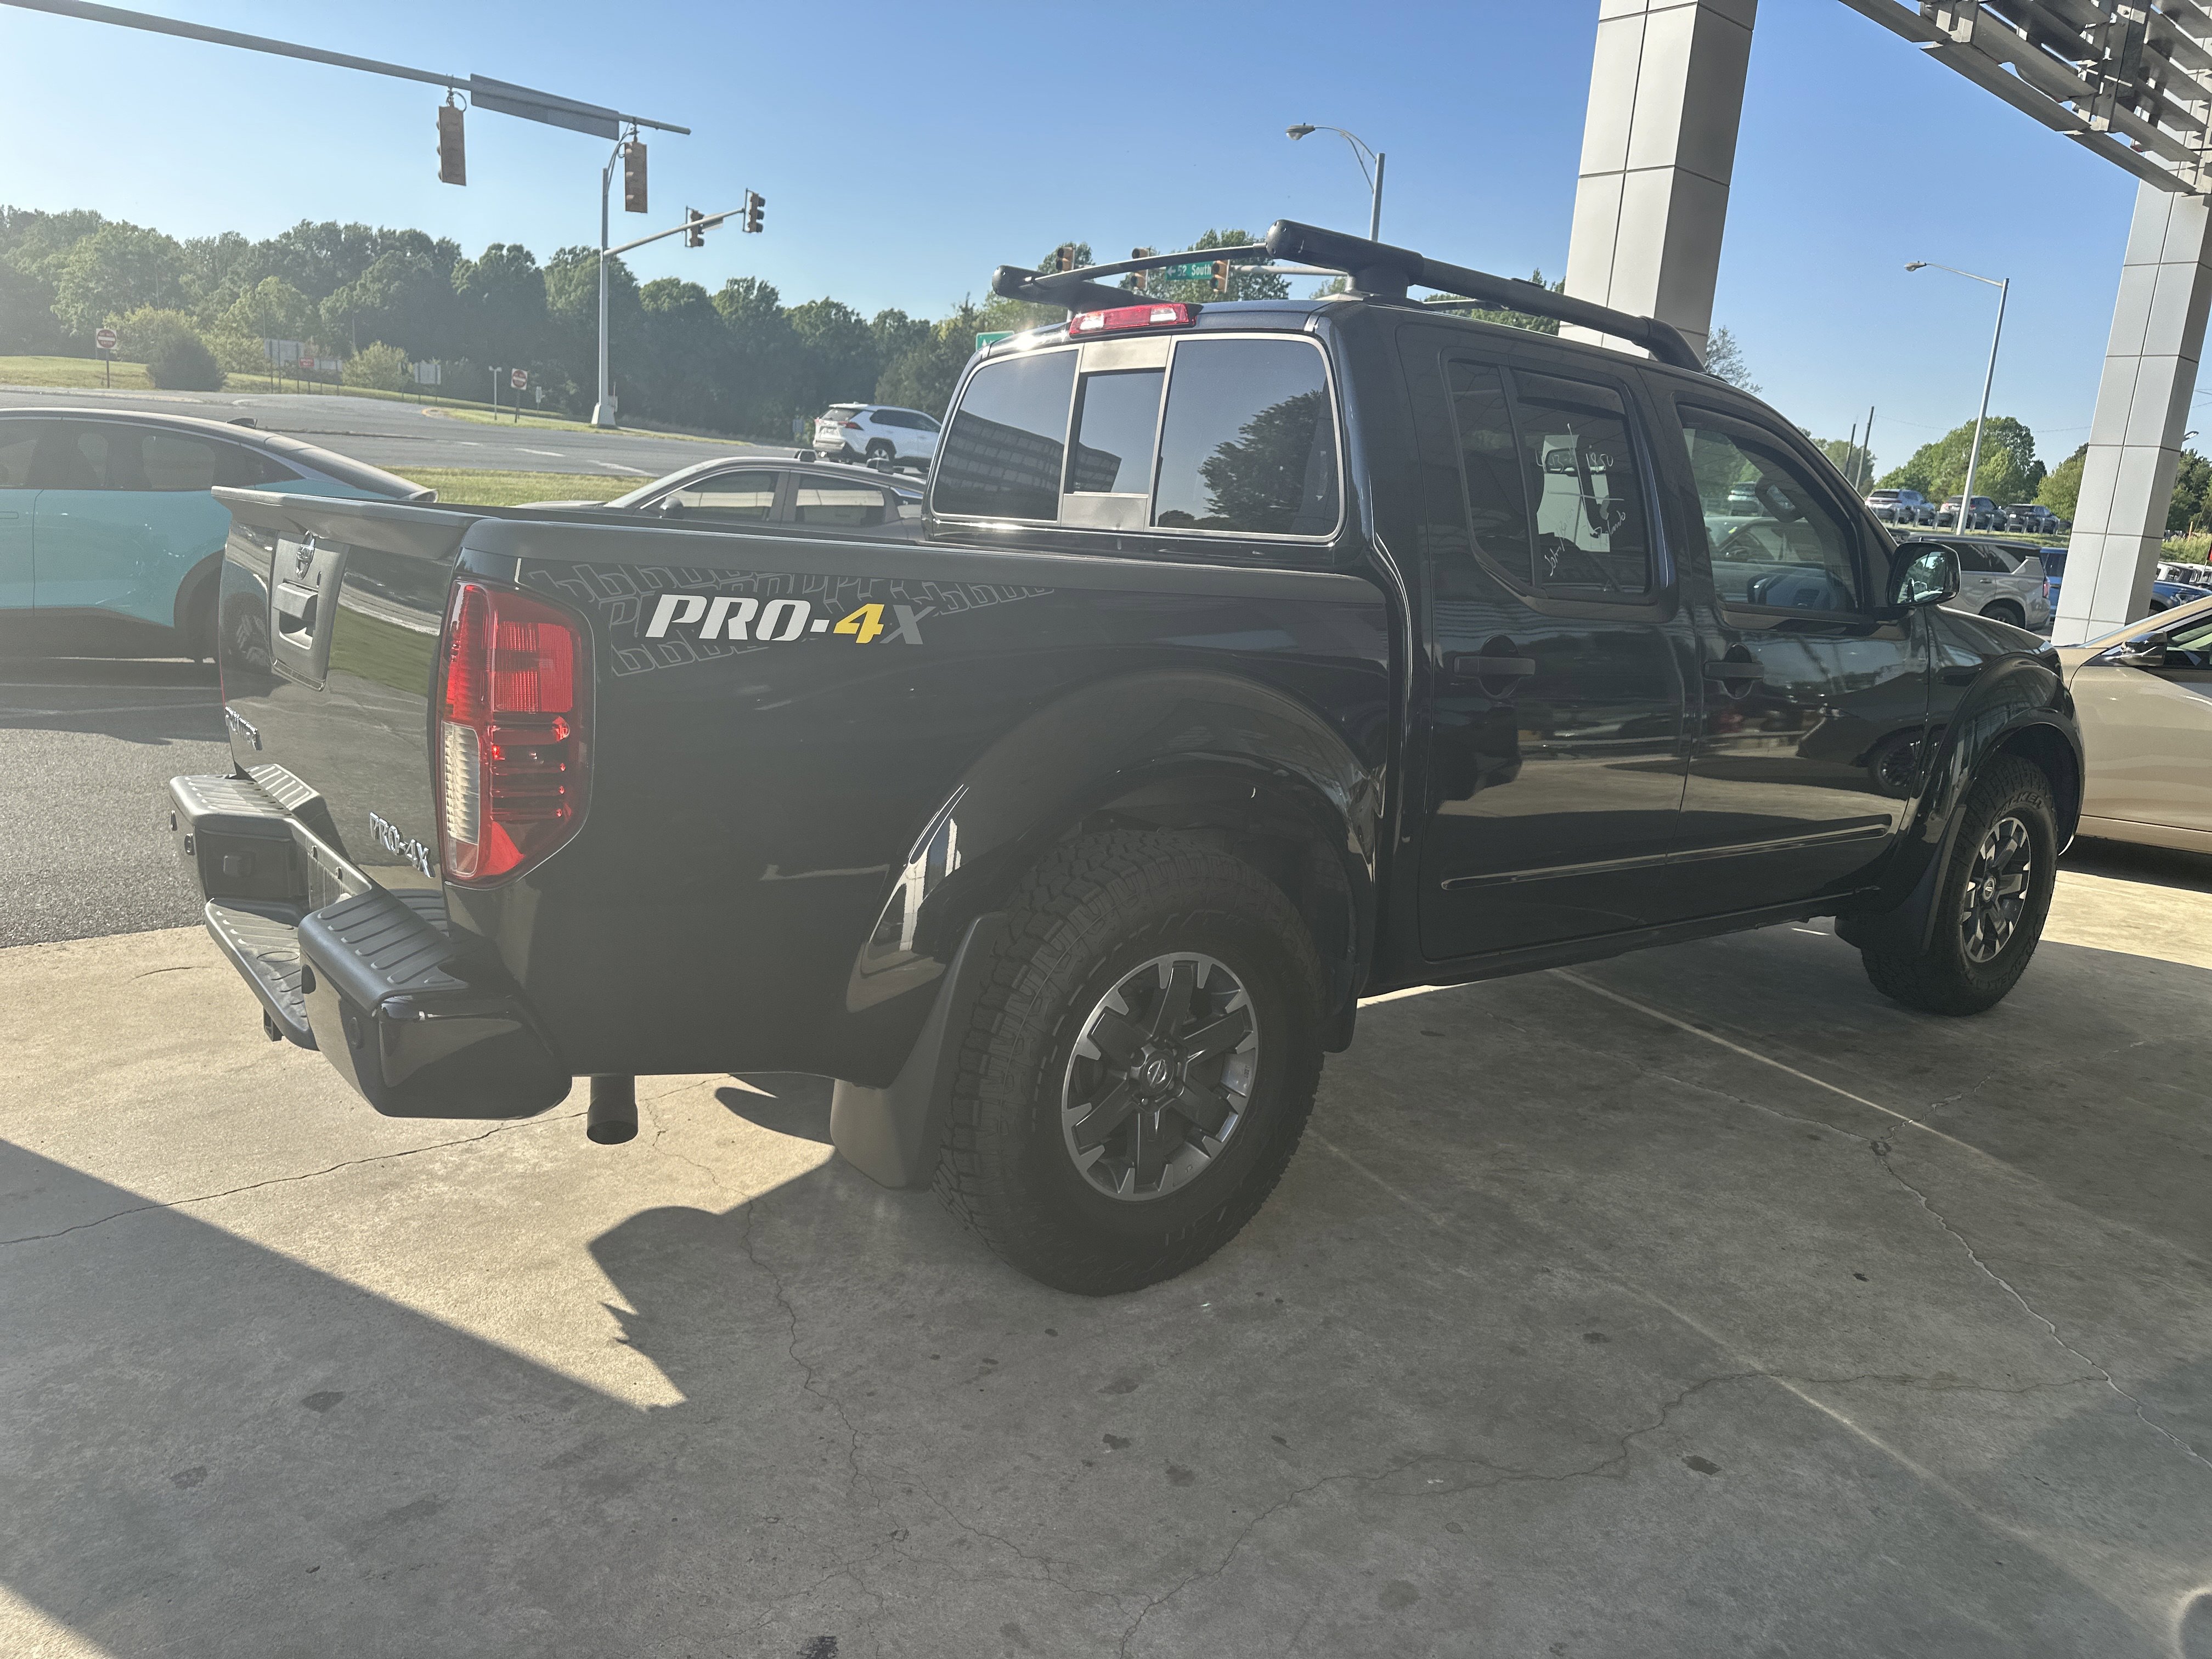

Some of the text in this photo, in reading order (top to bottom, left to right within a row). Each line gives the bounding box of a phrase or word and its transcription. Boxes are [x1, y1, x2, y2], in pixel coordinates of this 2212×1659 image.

[1178, 264, 1212, 276] 52 South
[645, 594, 936, 645] PRO-4X
[369, 811, 437, 879] PRO-4X
